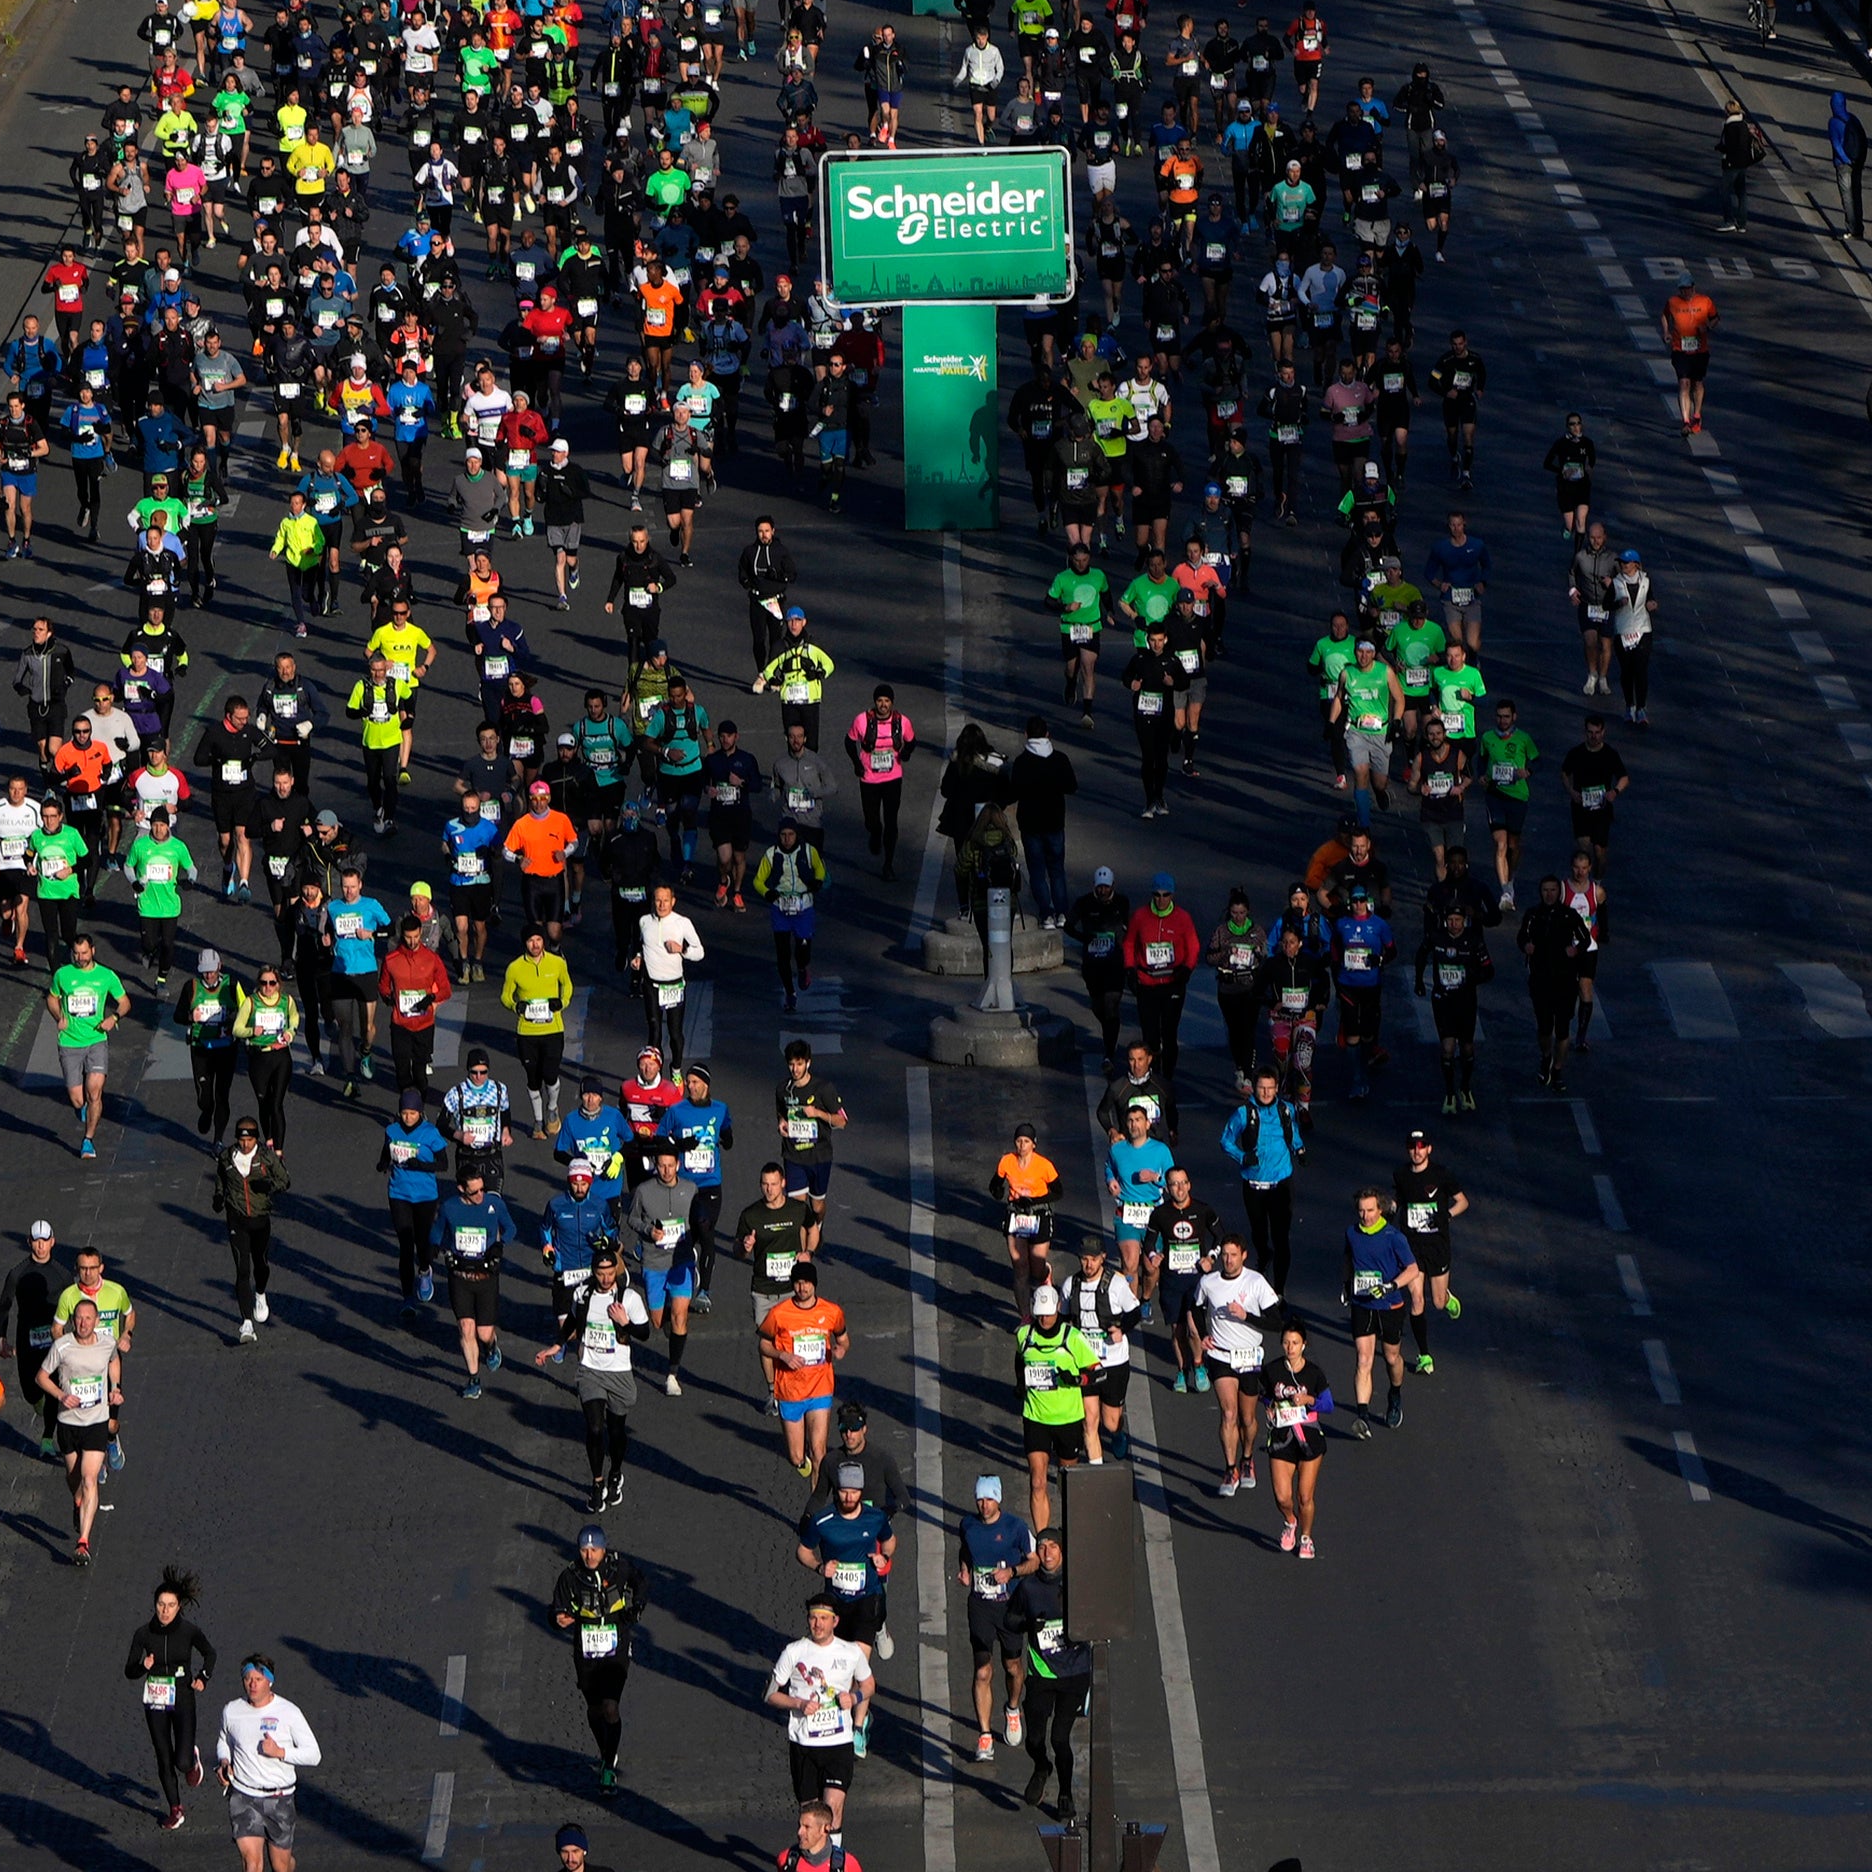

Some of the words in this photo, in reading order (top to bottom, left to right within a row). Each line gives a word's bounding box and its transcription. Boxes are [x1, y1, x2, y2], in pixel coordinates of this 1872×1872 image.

[847, 181, 1045, 220] Schneider
[934, 216, 1042, 239] Electric
[1644, 257, 1821, 279] BUS
[923, 356, 963, 364] Schneider
[939, 366, 969, 376] PARIS
[0, 819, 34, 827] IRELAND
